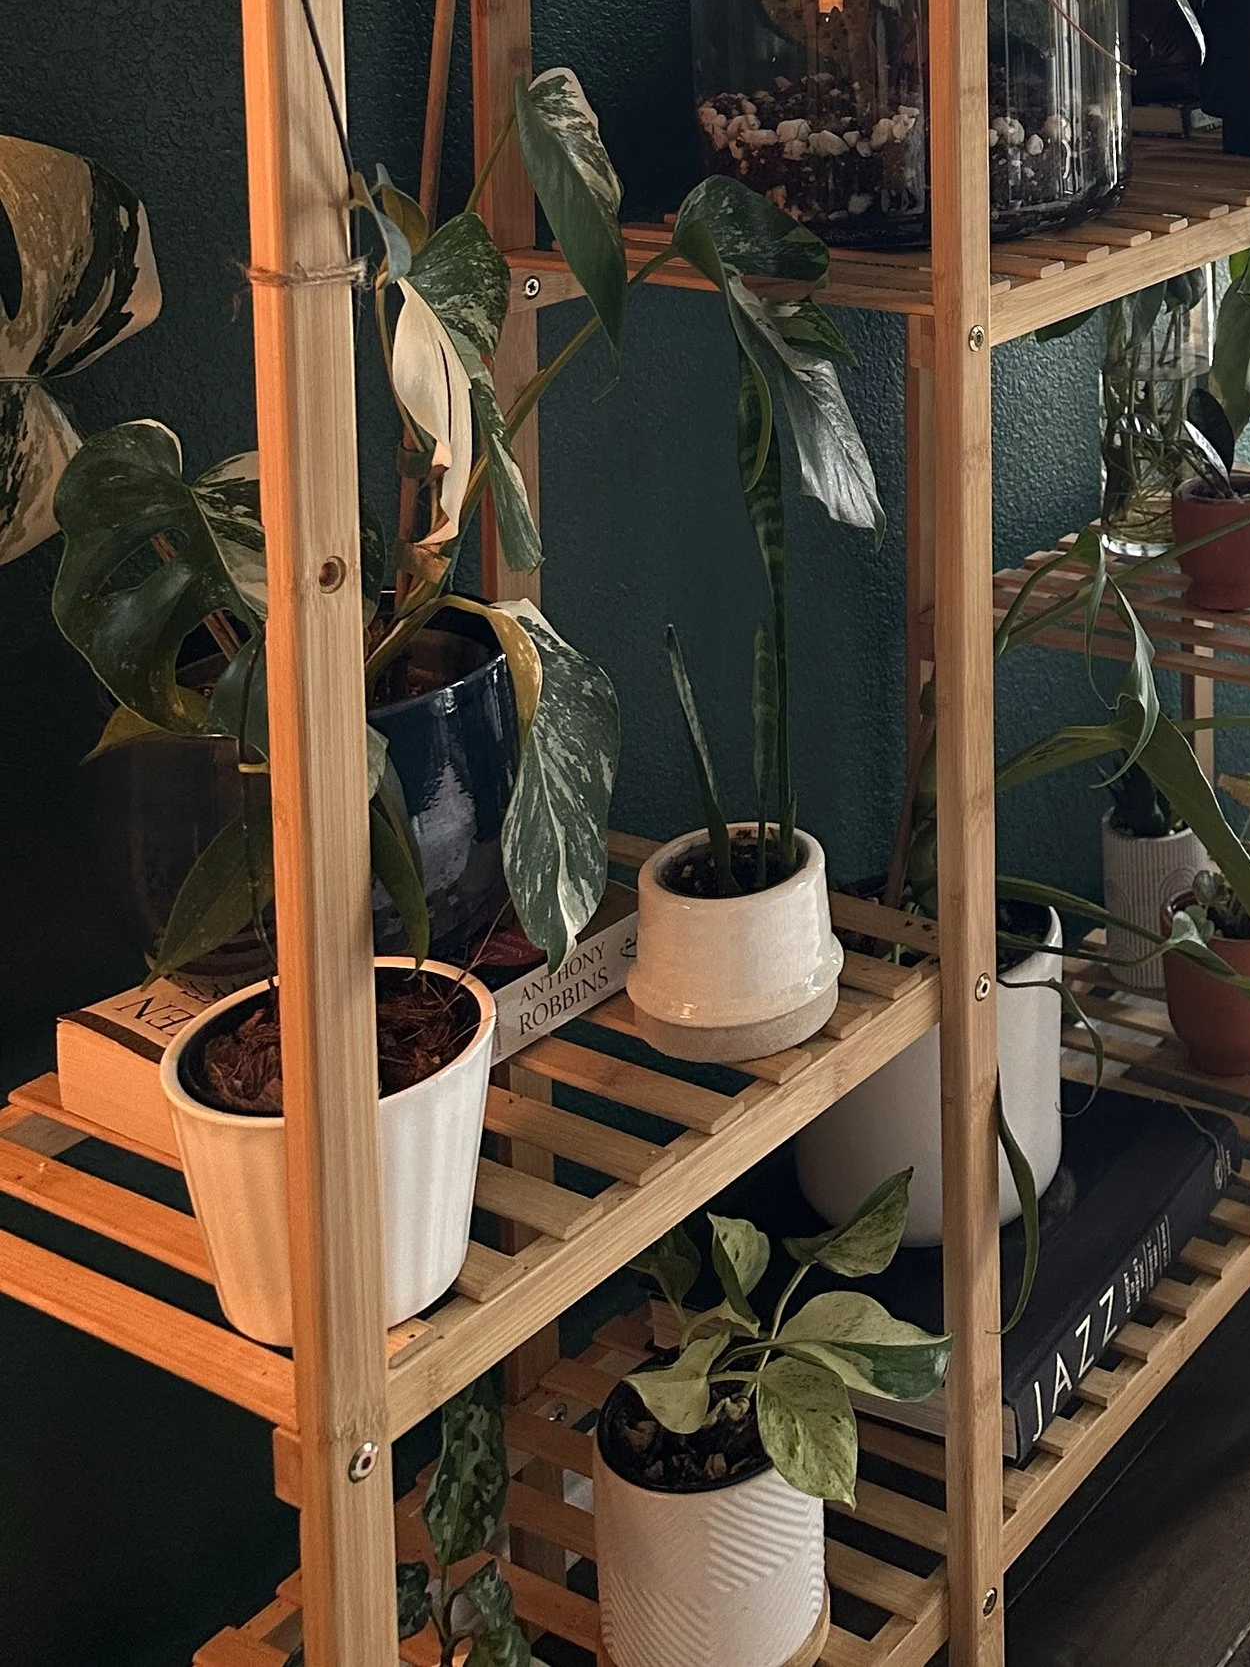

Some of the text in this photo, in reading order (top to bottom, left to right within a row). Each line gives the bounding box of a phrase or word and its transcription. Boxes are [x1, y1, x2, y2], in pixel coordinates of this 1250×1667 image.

[518, 967, 609, 1036] ROBBINS
[519, 941, 606, 1006] ANTHONY
[1031, 1284, 1118, 1442] JAZZ
